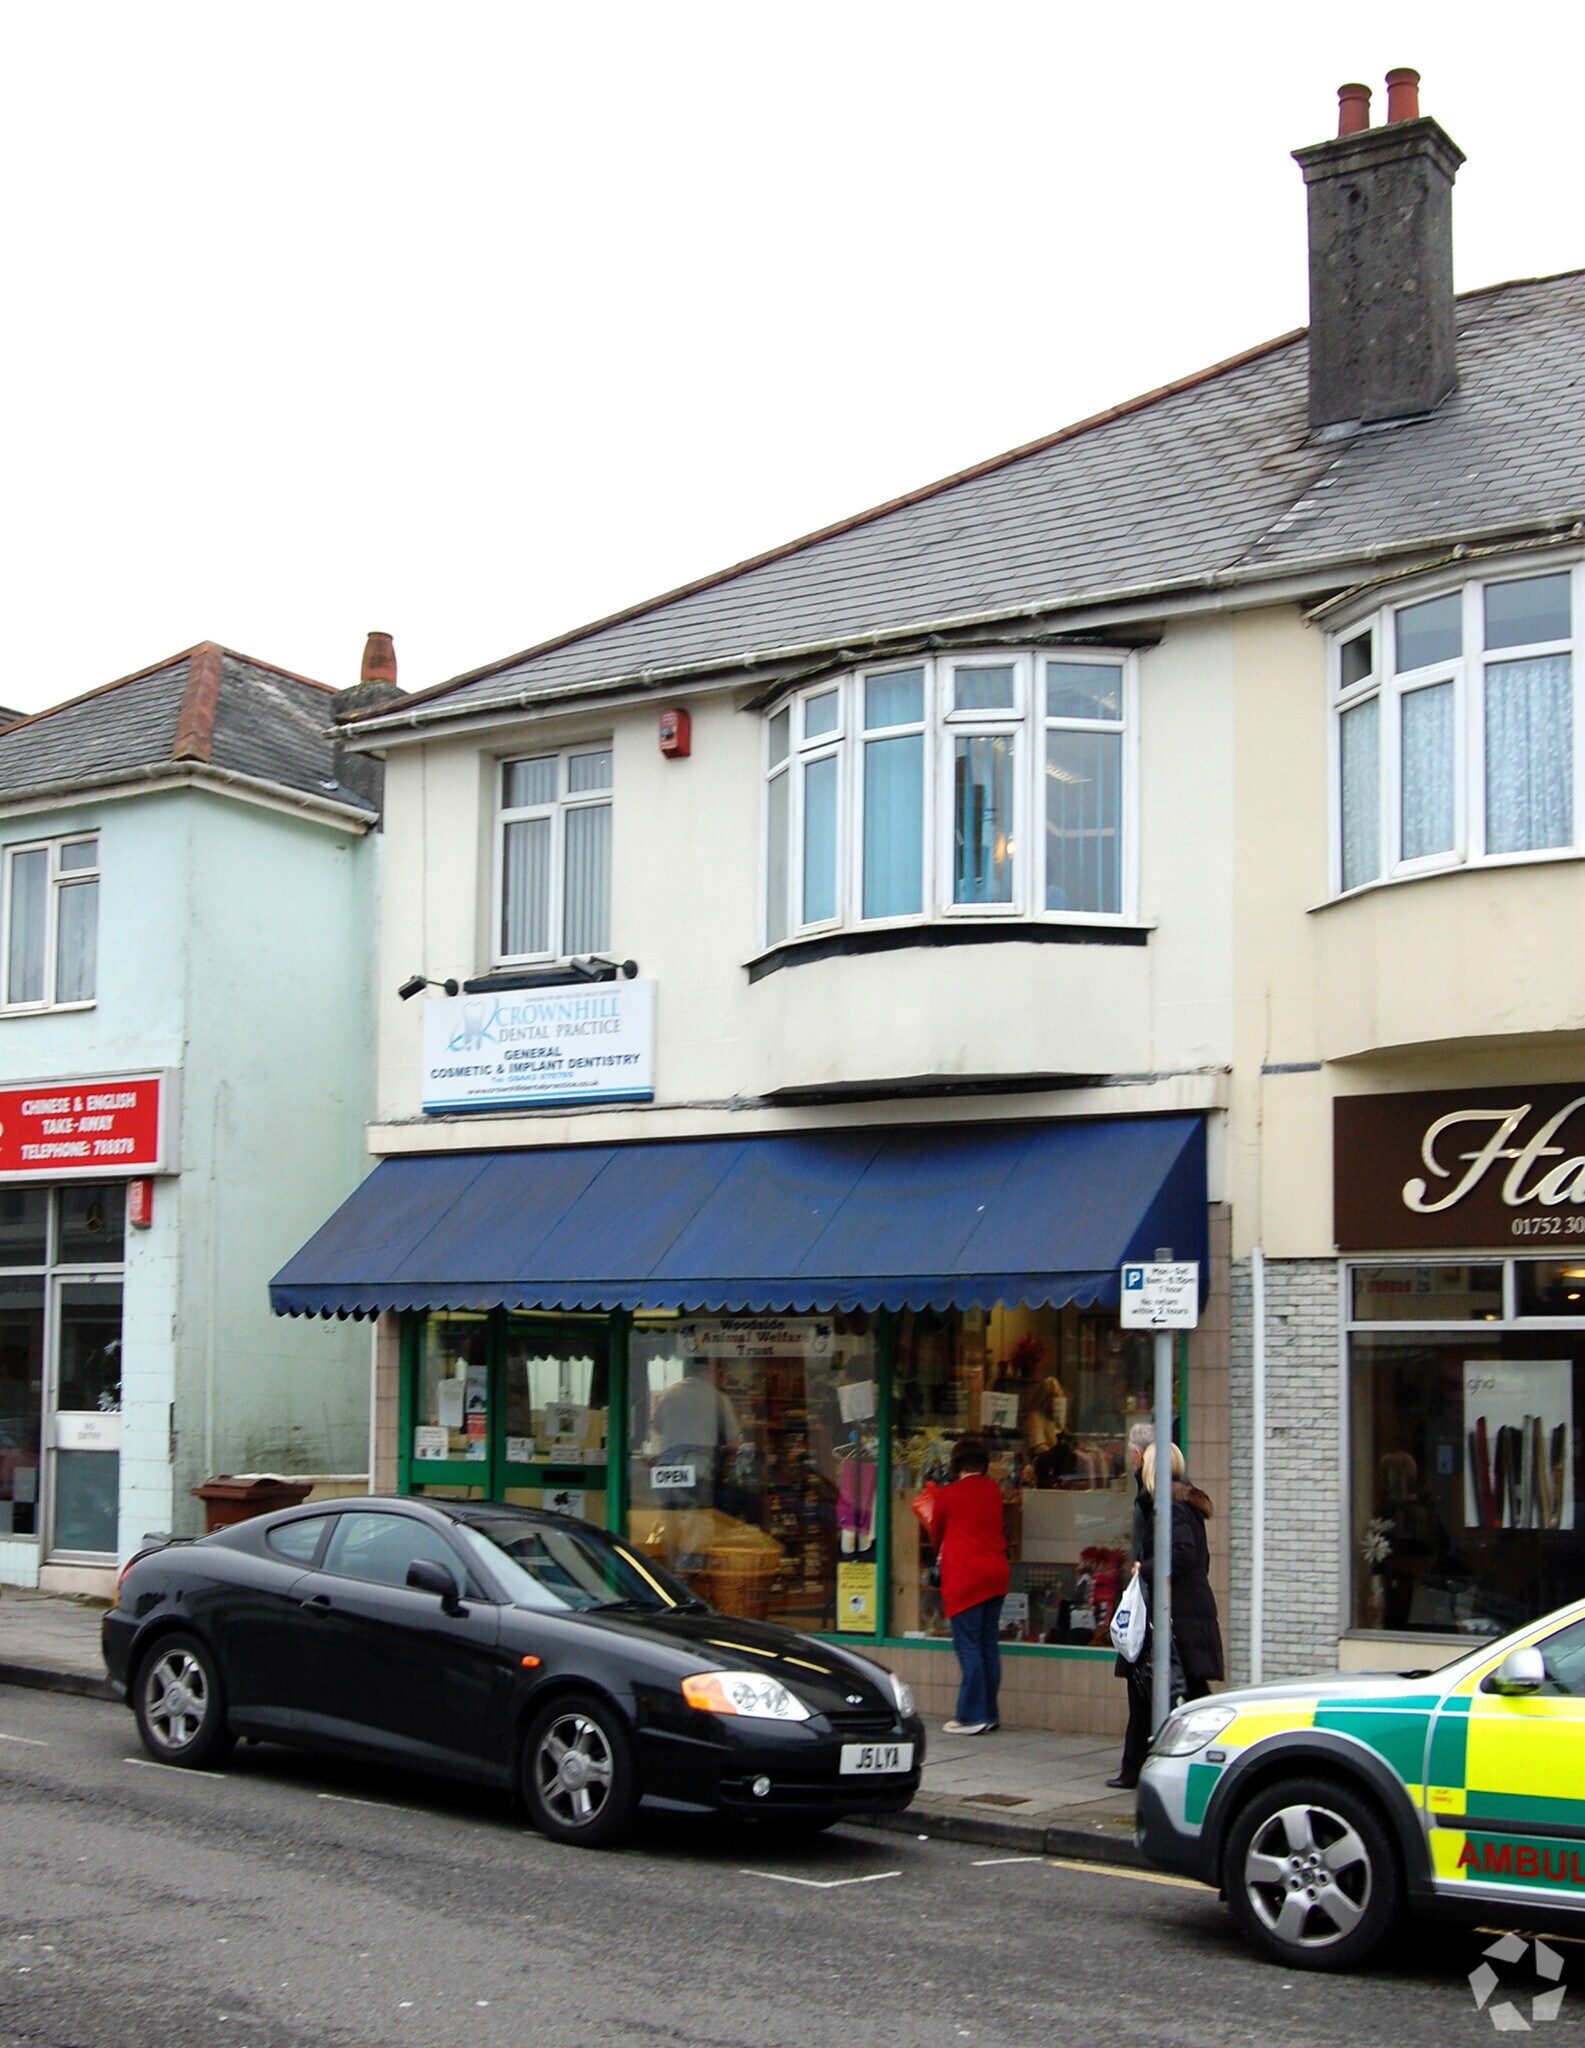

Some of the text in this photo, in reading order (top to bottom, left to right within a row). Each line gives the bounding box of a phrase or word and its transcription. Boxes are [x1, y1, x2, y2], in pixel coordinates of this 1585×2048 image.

[495, 997, 621, 1027] CROWNHILL
[499, 1019, 621, 1042] DENTAL PRACTICE
[504, 1046, 562, 1060] GENERAL
[430, 1053, 641, 1079] COSMETIC & IMPLANT DENTISTRY
[21, 1092, 137, 1116] CHINESE & ENGLISH
[41, 1114, 115, 1135] TAKE-AWAY
[1511, 1215, 1562, 1236] 01752
[701, 1331, 752, 1342] Animal
[736, 1344, 774, 1355] Trust
[655, 1470, 689, 1483] OPEN
[1456, 1840, 1585, 1885] AMBUL
